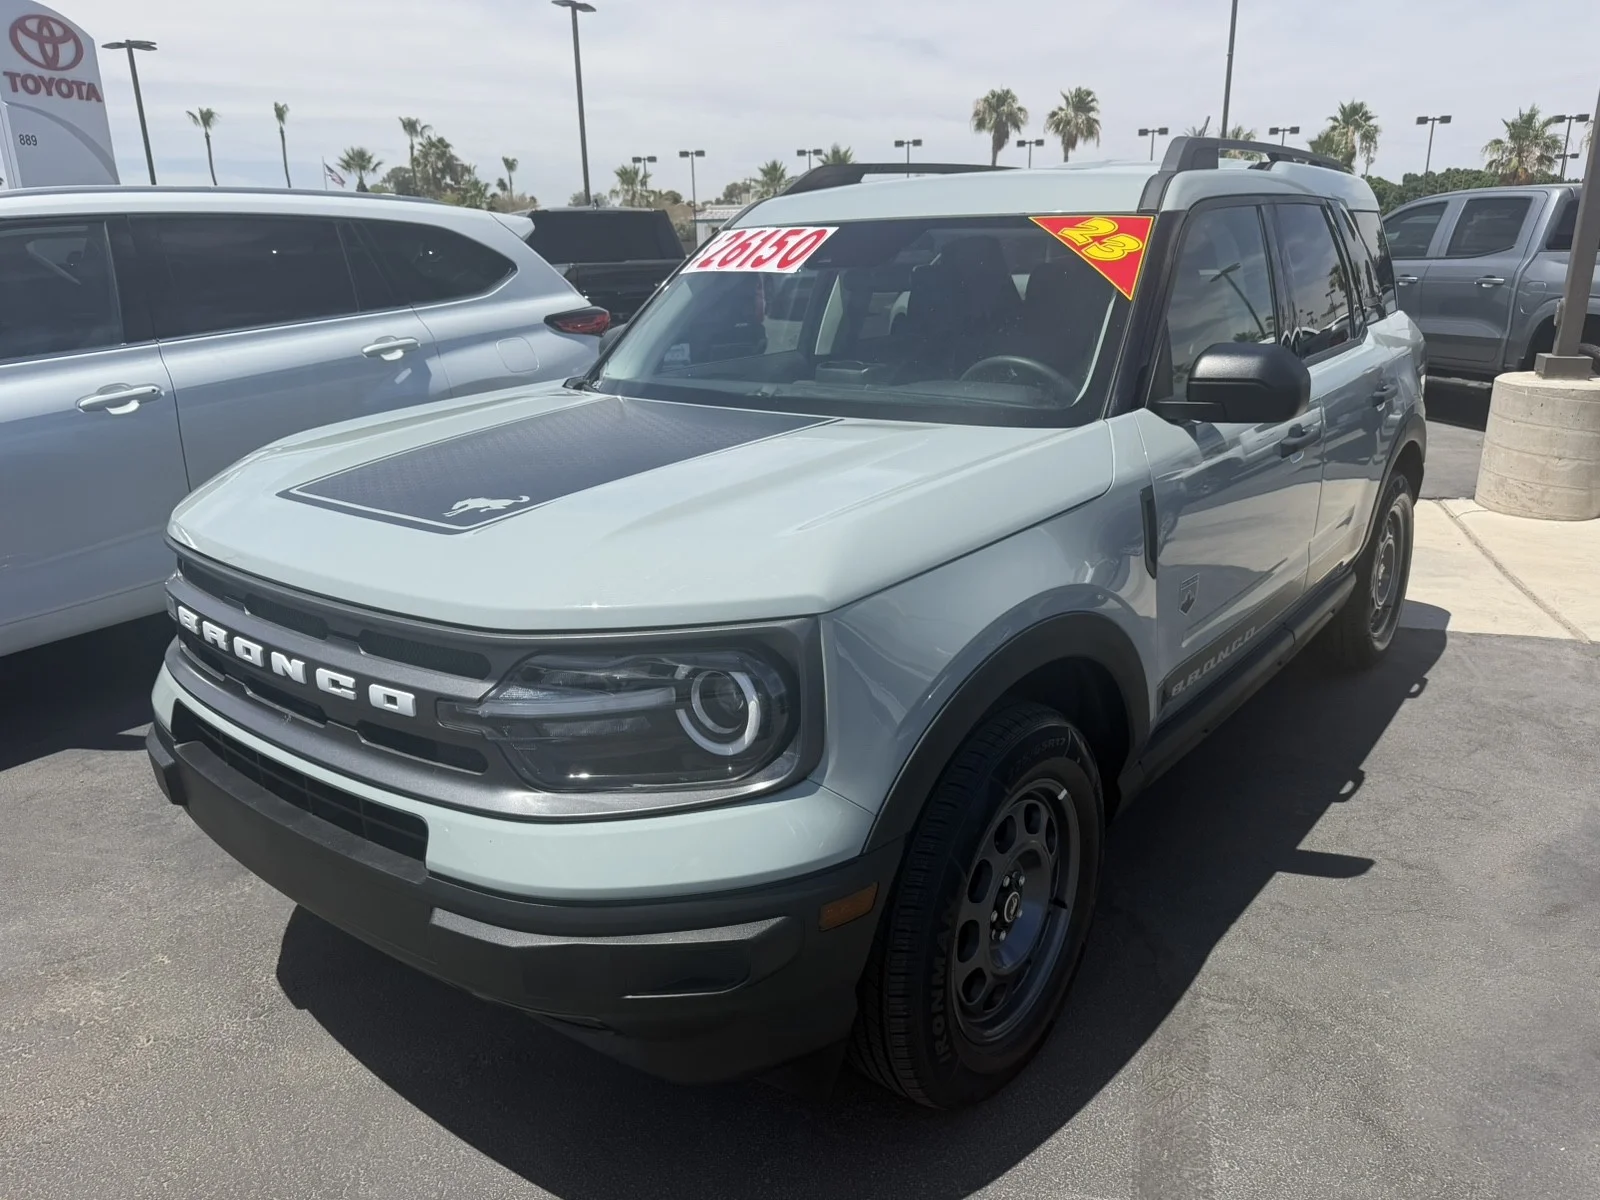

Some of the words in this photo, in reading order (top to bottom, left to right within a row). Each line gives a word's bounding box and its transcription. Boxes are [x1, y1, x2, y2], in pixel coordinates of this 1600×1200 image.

[3, 71, 103, 102] TOYOTA
[18, 134, 38, 146] 889
[1057, 217, 1143, 261] 23
[178, 605, 416, 717] BRONCO
[1171, 626, 1257, 697] BRONCO
